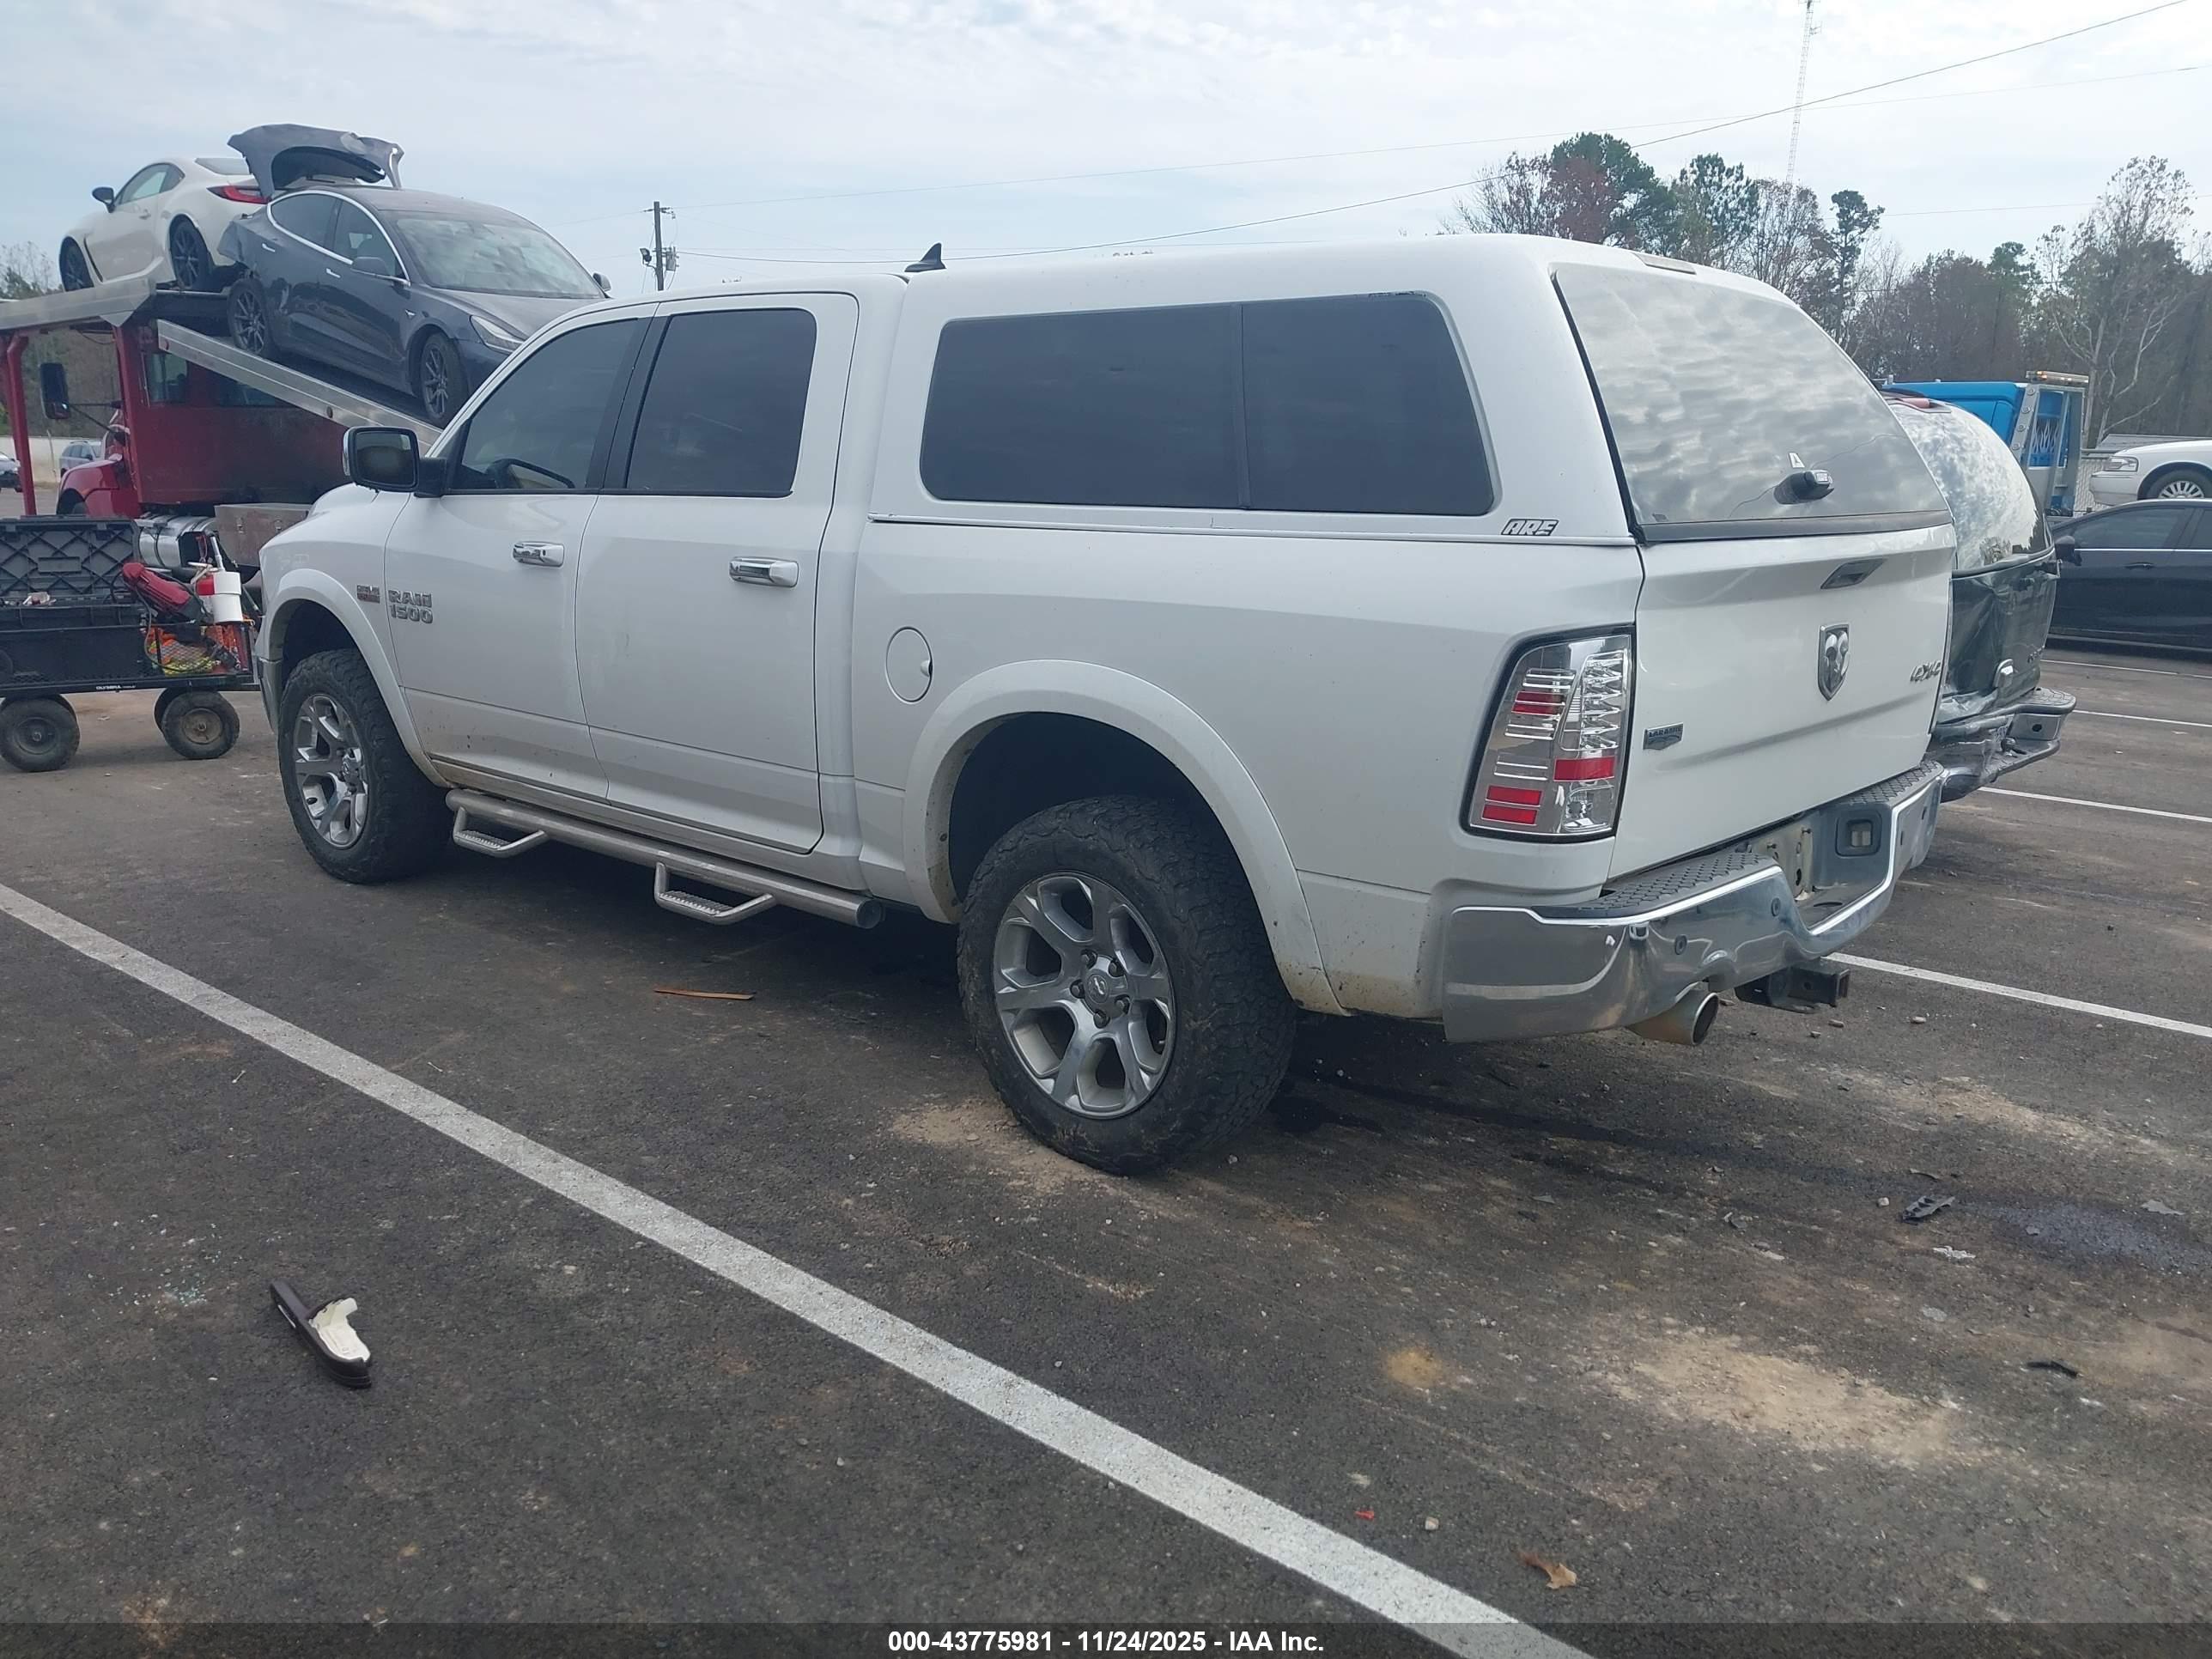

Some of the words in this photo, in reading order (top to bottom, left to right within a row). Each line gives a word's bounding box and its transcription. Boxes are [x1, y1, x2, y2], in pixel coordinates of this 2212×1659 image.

[1500, 518, 1559, 536] ARE
[388, 589, 432, 608] RAM
[389, 604, 434, 624] 1500
